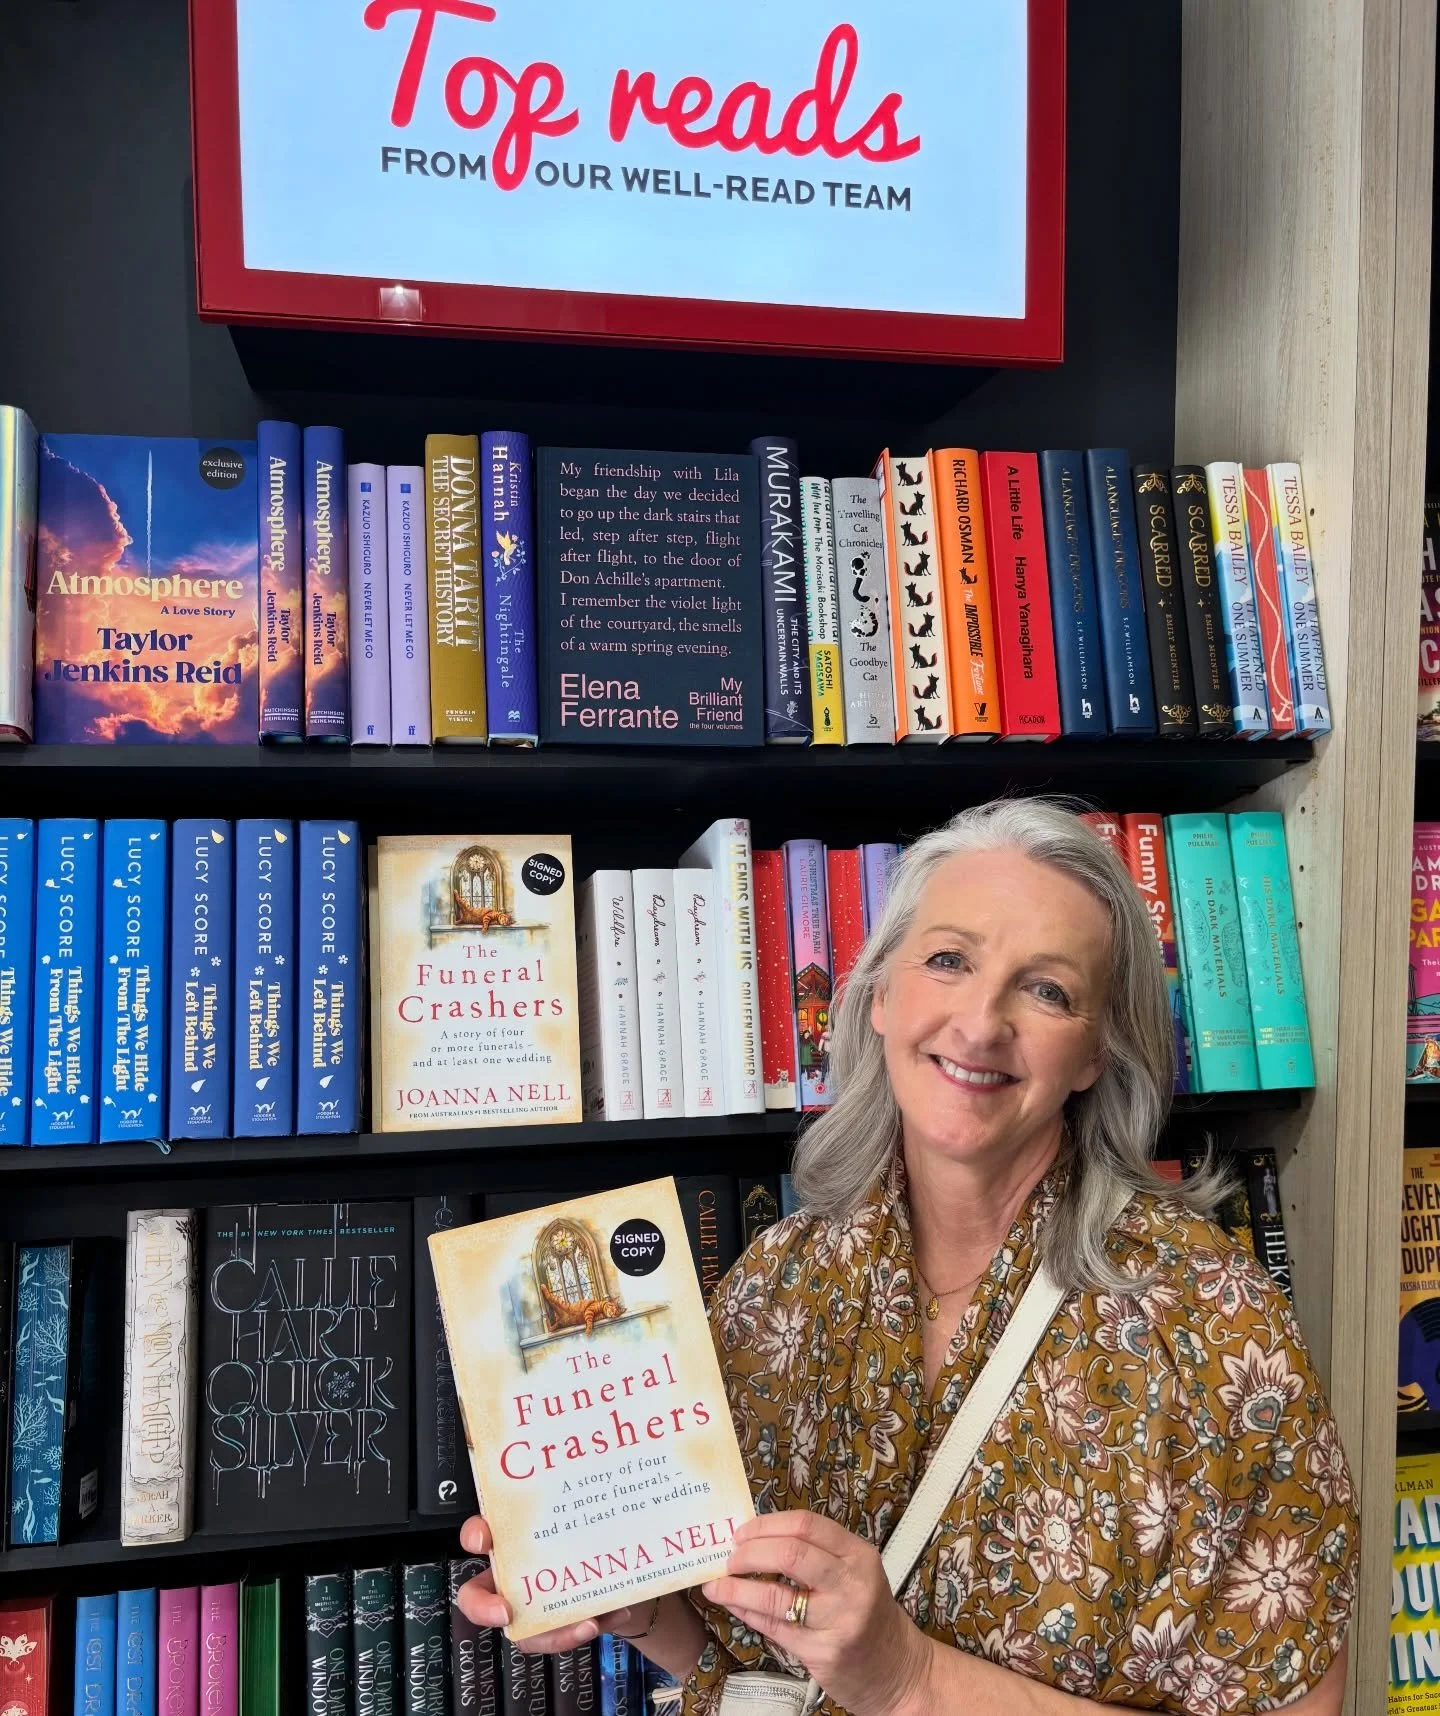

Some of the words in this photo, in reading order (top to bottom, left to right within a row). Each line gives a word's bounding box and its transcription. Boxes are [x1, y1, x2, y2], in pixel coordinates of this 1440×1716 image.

[363, 0, 580, 191] Top
[609, 23, 920, 163] reads
[380, 146, 487, 180] FROM
[534, 160, 612, 190] OUR
[622, 166, 815, 204] WELL-READ
[823, 182, 912, 211] TEAM
[202, 458, 243, 470] exclusive
[206, 469, 238, 480] edition
[432, 455, 450, 493] THE
[560, 463, 582, 477] My
[594, 463, 661, 480] friendship
[673, 468, 702, 480] with
[714, 468, 740, 481] Lila
[1007, 465, 1019, 476] A
[492, 446, 509, 521] Hannah
[510, 461, 521, 507] Kristin
[559, 485, 600, 500] began
[606, 486, 628, 499] the
[634, 488, 657, 502] day
[663, 491, 682, 501] we
[688, 489, 740, 503] decided
[850, 495, 867, 504] The
[1008, 480, 1021, 512] Little
[1284, 476, 1301, 526] TESSA
[267, 456, 288, 572] Atmosphere
[362, 499, 371, 530] KAZUO
[450, 455, 477, 553] DONNA
[560, 509, 574, 519] to
[577, 510, 594, 524] go
[598, 511, 615, 524] up
[618, 508, 640, 520] the
[643, 509, 673, 521] dark
[676, 510, 712, 523] stairs
[715, 512, 740, 524] that
[838, 510, 880, 522] Travelling
[432, 496, 452, 565] SECRET
[766, 446, 797, 602] MURAKAMI
[853, 524, 868, 533] Cat
[958, 515, 975, 564] OSMAN
[1011, 516, 1024, 540] Life
[362, 531, 372, 576] ISHIGURO
[814, 537, 823, 552] The
[839, 540, 883, 548] Chronicles
[1149, 504, 1172, 587] SCARRED
[1188, 505, 1211, 587] SCARRED
[1290, 531, 1310, 586] BAILEY
[46, 570, 244, 601] Atmosphere
[815, 555, 824, 593] Morisaki
[1014, 556, 1027, 599] Hanya
[160, 606, 169, 615] A
[172, 606, 201, 616] Love
[203, 606, 236, 618] Story
[266, 590, 278, 634] Jenkins
[363, 582, 373, 612] NEVER
[434, 568, 454, 647] HISTORY
[453, 559, 481, 652] TARTT
[963, 589, 974, 603] The
[279, 609, 290, 644] Taylor
[364, 613, 373, 628] LET
[790, 619, 798, 637] THE
[816, 597, 827, 639] Bookshop
[964, 603, 983, 657] IMPOSSIBLE
[1293, 602, 1306, 629] ONE
[97, 627, 193, 655] Taylor
[267, 635, 278, 662] Reid
[364, 629, 373, 644] ME
[365, 644, 374, 659] GO
[496, 595, 513, 688] Nightingale
[514, 629, 525, 653] The
[775, 608, 788, 664] UNCERTAIN
[791, 639, 800, 659] CITY
[860, 642, 877, 652] The
[1019, 603, 1034, 679] Yanagihara
[44, 659, 169, 684] Jenkins
[175, 660, 242, 684] Reid
[779, 664, 789, 696] WALLS
[792, 660, 800, 680] AND
[815, 651, 825, 697] YAGISAWA
[824, 650, 833, 689] SATOSHI
[849, 658, 888, 668] Goodbye
[863, 672, 878, 681] Cat
[1297, 633, 1314, 690] SUMMER
[560, 673, 640, 700] Elena
[689, 692, 743, 706] Brilliant
[720, 677, 743, 694] My
[794, 682, 802, 695] ITS
[560, 701, 679, 730] Ferrante
[689, 722, 699, 730] the
[701, 722, 713, 730] four
[715, 722, 743, 730] volumes
[696, 707, 743, 722] Friend
[60, 836, 75, 884] LUCY
[195, 837, 208, 883] LUCY
[735, 844, 746, 857] IT
[1137, 824, 1157, 895] Funny
[800, 859, 809, 893] LAURIE
[808, 859, 819, 906] CHRISTMAS
[1204, 878, 1214, 896] HIS
[59, 894, 74, 958] SCORE
[194, 893, 208, 955] SCORE
[610, 896, 626, 947] Wildfire
[646, 894, 666, 947] Daydream
[737, 906, 751, 945] WITH
[802, 896, 810, 939] GILMORE
[811, 908, 820, 930] TREE
[1208, 900, 1219, 930] DARK
[463, 945, 497, 959] The
[813, 931, 821, 954] FARM
[417, 960, 544, 986] Funeral
[1212, 935, 1227, 998] MATERIALS
[50, 968, 63, 1013] From
[64, 966, 83, 1024] Things
[186, 981, 199, 1013] Left
[398, 990, 563, 1023] Crashers
[200, 984, 217, 1040] Things
[656, 1003, 665, 1046] HANNAH
[49, 1016, 63, 1047] The
[67, 1026, 81, 1053] We
[185, 1016, 198, 1072] Behind
[44, 1048, 62, 1094] Light
[66, 1055, 81, 1095] Hide
[203, 1044, 216, 1069] We
[397, 1087, 498, 1110] JOANNA
[508, 1084, 571, 1101] NELL
[614, 1233, 660, 1244] SIGNED
[699, 1190, 718, 1250] CALLIE
[621, 1246, 655, 1258] COPY
[211, 1255, 397, 1314] CALLIE
[232, 1306, 377, 1363] HART
[566, 1351, 612, 1375] The
[205, 1357, 399, 1416] QUICK
[513, 1352, 677, 1427] Funeral
[210, 1408, 392, 1470] SILVER
[500, 1401, 710, 1480] Crashers
[553, 1504, 566, 1514] or
[574, 1492, 608, 1510] more
[613, 1472, 670, 1499] funerals
[562, 1481, 572, 1494] A
[578, 1470, 613, 1488] story
[619, 1462, 632, 1474] of
[638, 1455, 668, 1471] four
[533, 1523, 559, 1540] and
[565, 1518, 578, 1531] at
[584, 1507, 617, 1527] least
[622, 1500, 646, 1513] one
[652, 1481, 711, 1506] wedding
[521, 1544, 653, 1605] JOANNA
[543, 1599, 569, 1613] FROM
[636, 1560, 695, 1583] BESTSELLING
[211, 1599, 220, 1622] THE
[427, 1635, 443, 1675] ONE
[459, 1639, 476, 1707] CROWNS
[410, 1643, 426, 1714] WINDOW
